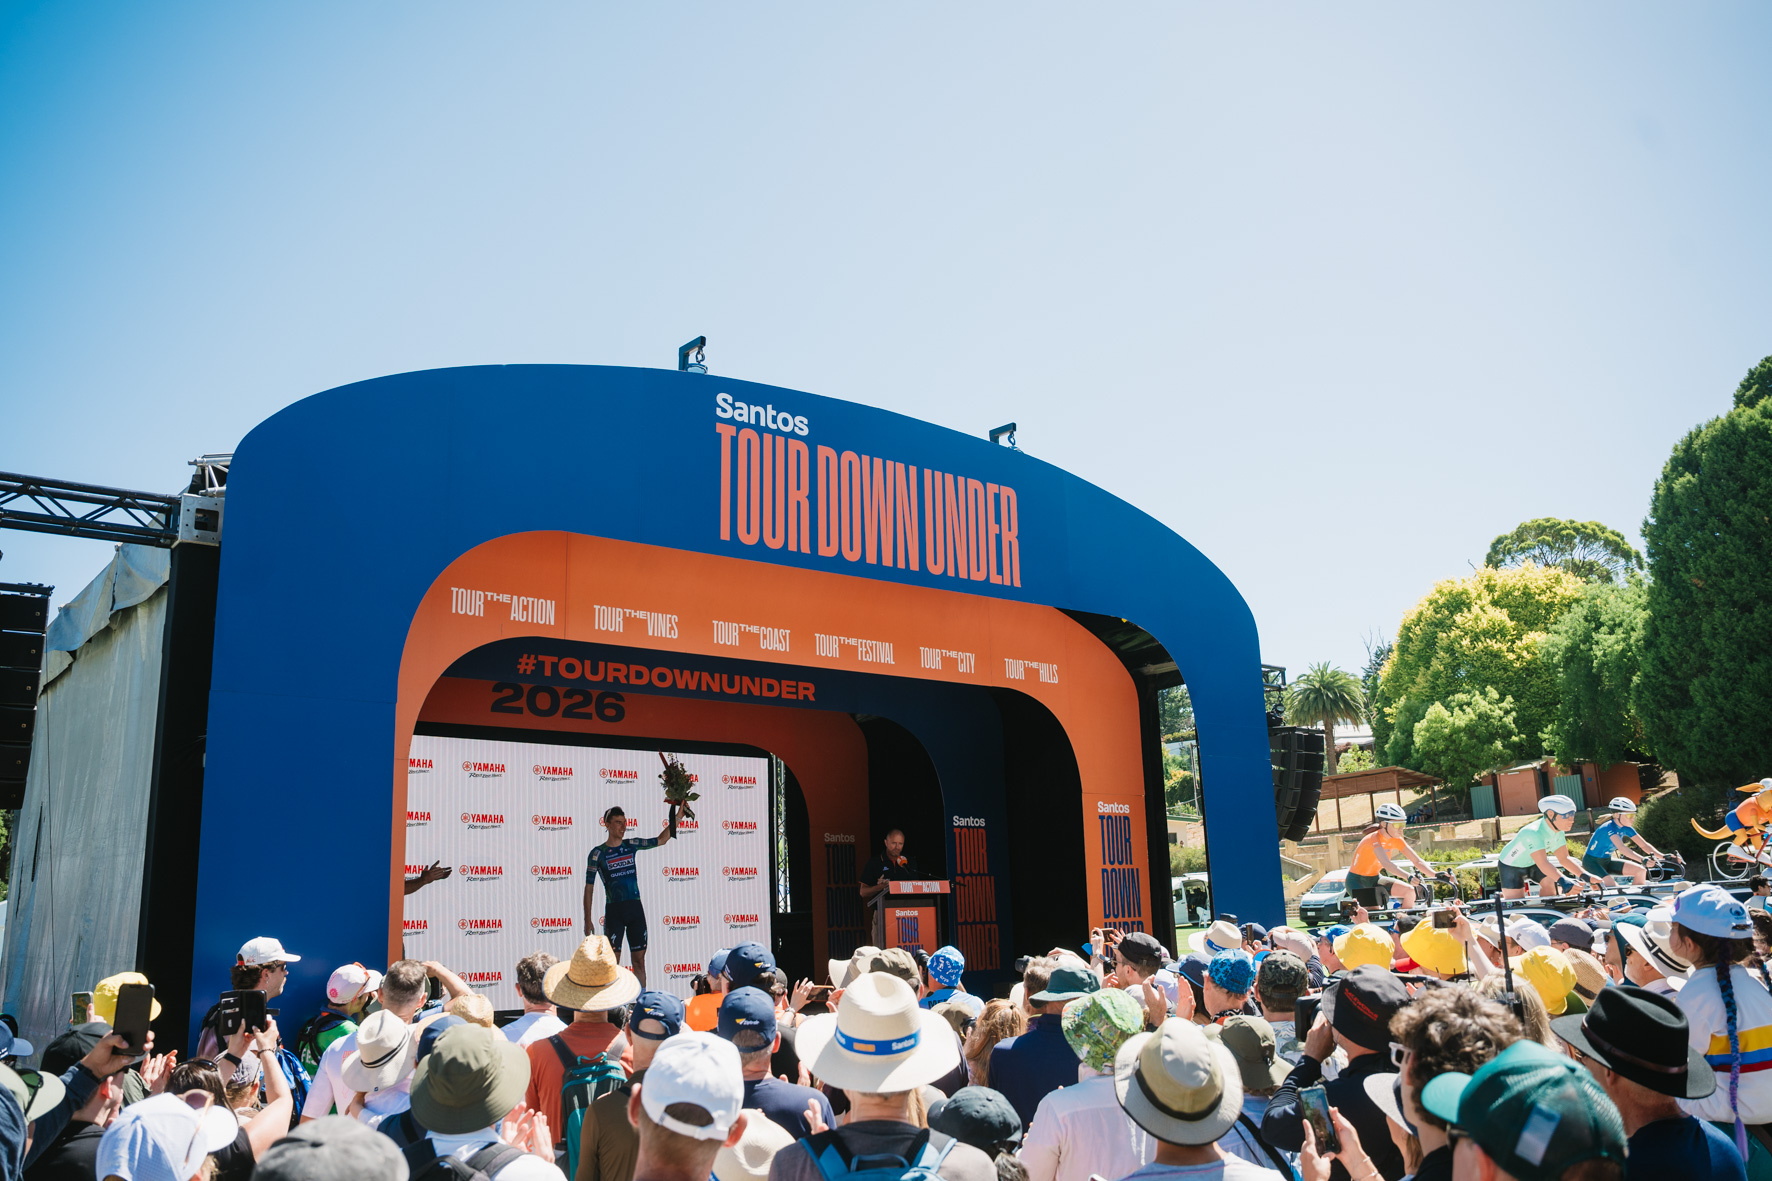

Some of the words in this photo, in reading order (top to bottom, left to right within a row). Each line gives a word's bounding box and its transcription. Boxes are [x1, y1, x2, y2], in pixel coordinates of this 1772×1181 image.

[716, 392, 809, 436] Santos
[716, 422, 810, 554] TOUR
[817, 444, 919, 572] DOWN
[924, 468, 1021, 588] UNDER
[451, 587, 484, 617] TOUR
[485, 592, 511, 603] THE
[510, 596, 555, 626] ACTION
[594, 605, 623, 632] TOUR
[624, 609, 647, 619] THE
[647, 612, 678, 639] VINES
[712, 620, 739, 646] TOUR
[739, 624, 760, 633] THE
[760, 627, 790, 652] COAST
[815, 634, 839, 658] TOUR
[839, 637, 858, 646] THE
[858, 639, 895, 664] FESTIVAL
[920, 647, 941, 670] TOUR
[942, 650, 958, 658] THE
[958, 652, 975, 674] CITY
[1004, 658, 1025, 680] TOUR
[1039, 663, 1058, 684] HILLS
[517, 654, 815, 701] #TOURDOWNUNDER
[490, 682, 626, 722] 2026
[410, 758, 433, 768] MAHA
[473, 762, 506, 773] YAMAHA
[542, 766, 573, 776] YAMAHA
[608, 769, 638, 779] YAMAHA
[729, 776, 756, 785] YAMAHA
[1098, 801, 1130, 814] Santos
[406, 812, 431, 821] MAHA
[471, 814, 504, 824] YAMAHA
[541, 816, 572, 825] YAMAHA
[953, 815, 985, 827] Santos
[676, 820, 699, 828] MAHA
[730, 821, 757, 830] YAMAHA
[824, 832, 855, 842] Santos
[1099, 815, 1132, 865] TOUR
[954, 828, 988, 874] TOUR
[825, 844, 856, 884] TOUR
[470, 866, 503, 875] YAMAHA
[541, 866, 572, 875] YAMAHA
[671, 867, 699, 876] YAMAHA
[731, 867, 757, 875] YAMAHA
[900, 882, 913, 892] TOUR
[923, 882, 940, 892] ACTION
[1102, 868, 1141, 919] DOWN
[956, 876, 996, 922] DOWN
[826, 886, 864, 928] DOWN
[541, 918, 572, 927] YAMAHA
[672, 916, 700, 924] YAMAHA
[732, 914, 758, 922] YAMAHA
[403, 920, 428, 929] MAHA
[469, 919, 502, 929] YAMAHA
[896, 917, 919, 943] TOUR
[958, 924, 1000, 971] UNDER
[672, 963, 701, 972] YAMAHA
[468, 972, 502, 981] YAMAHA
